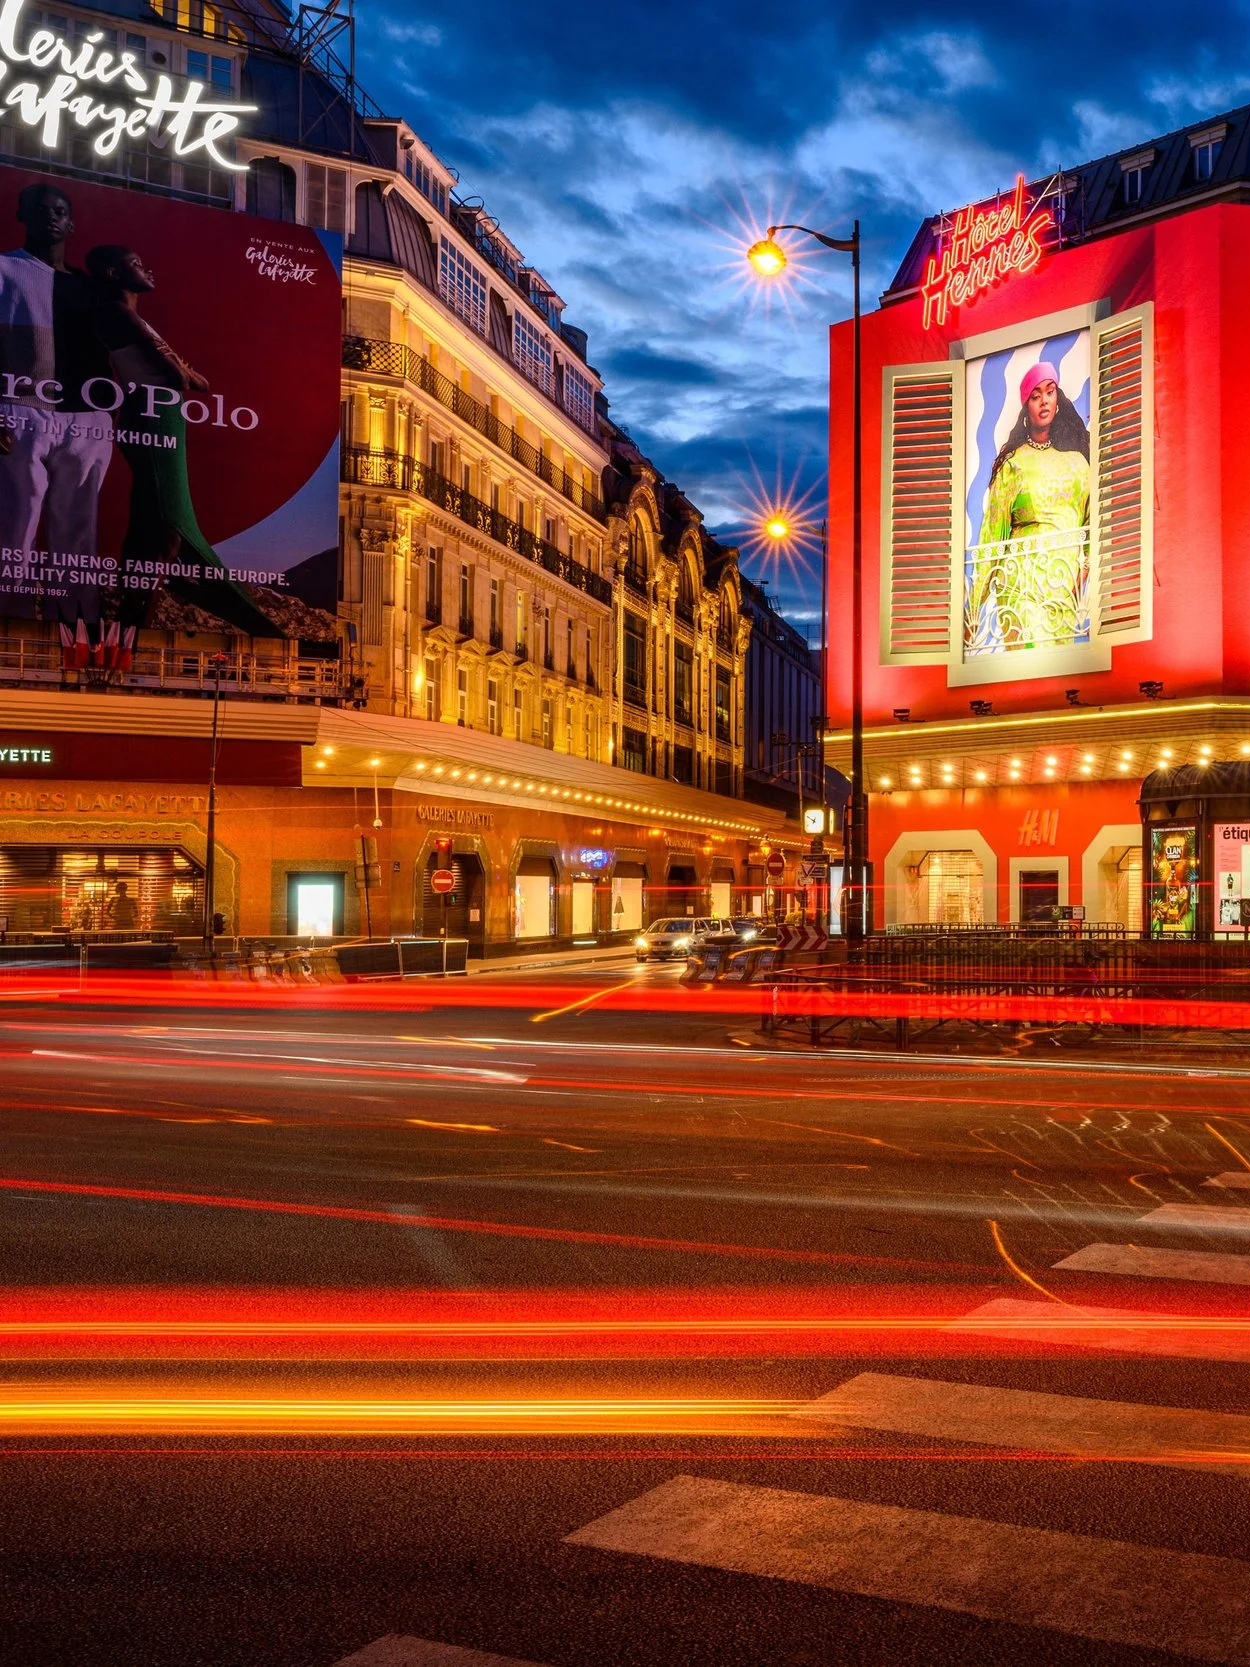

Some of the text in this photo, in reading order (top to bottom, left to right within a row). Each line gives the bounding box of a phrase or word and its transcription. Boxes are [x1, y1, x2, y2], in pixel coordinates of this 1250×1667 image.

[0, 60, 258, 170] afayette
[952, 175, 1025, 268] Hôtel
[245, 246, 295, 264] Galeries
[266, 240, 294, 250] VENTE
[258, 262, 318, 285] Lafayette
[922, 213, 1050, 330] Hennes
[1, 372, 64, 404] rc
[42, 418, 62, 436] IN
[70, 423, 177, 449] STOCKHOLM
[1, 565, 66, 583] ABILITY
[69, 571, 118, 587] SINCE
[2, 548, 23, 562] RS
[29, 550, 49, 565] OF
[126, 559, 200, 578] FABRIQUÉ
[205, 566, 224, 580] EN
[229, 568, 290, 587] EUROPE.
[0, 584, 69, 597] LE DEPUIS 1967.
[0, 749, 51, 762] YETTE
[0, 792, 65, 812] RIES
[417, 804, 494, 826] GALERIES LAFAYETTE
[68, 830, 182, 840] LA COUPOLE
[1018, 808, 1059, 847] H&M
